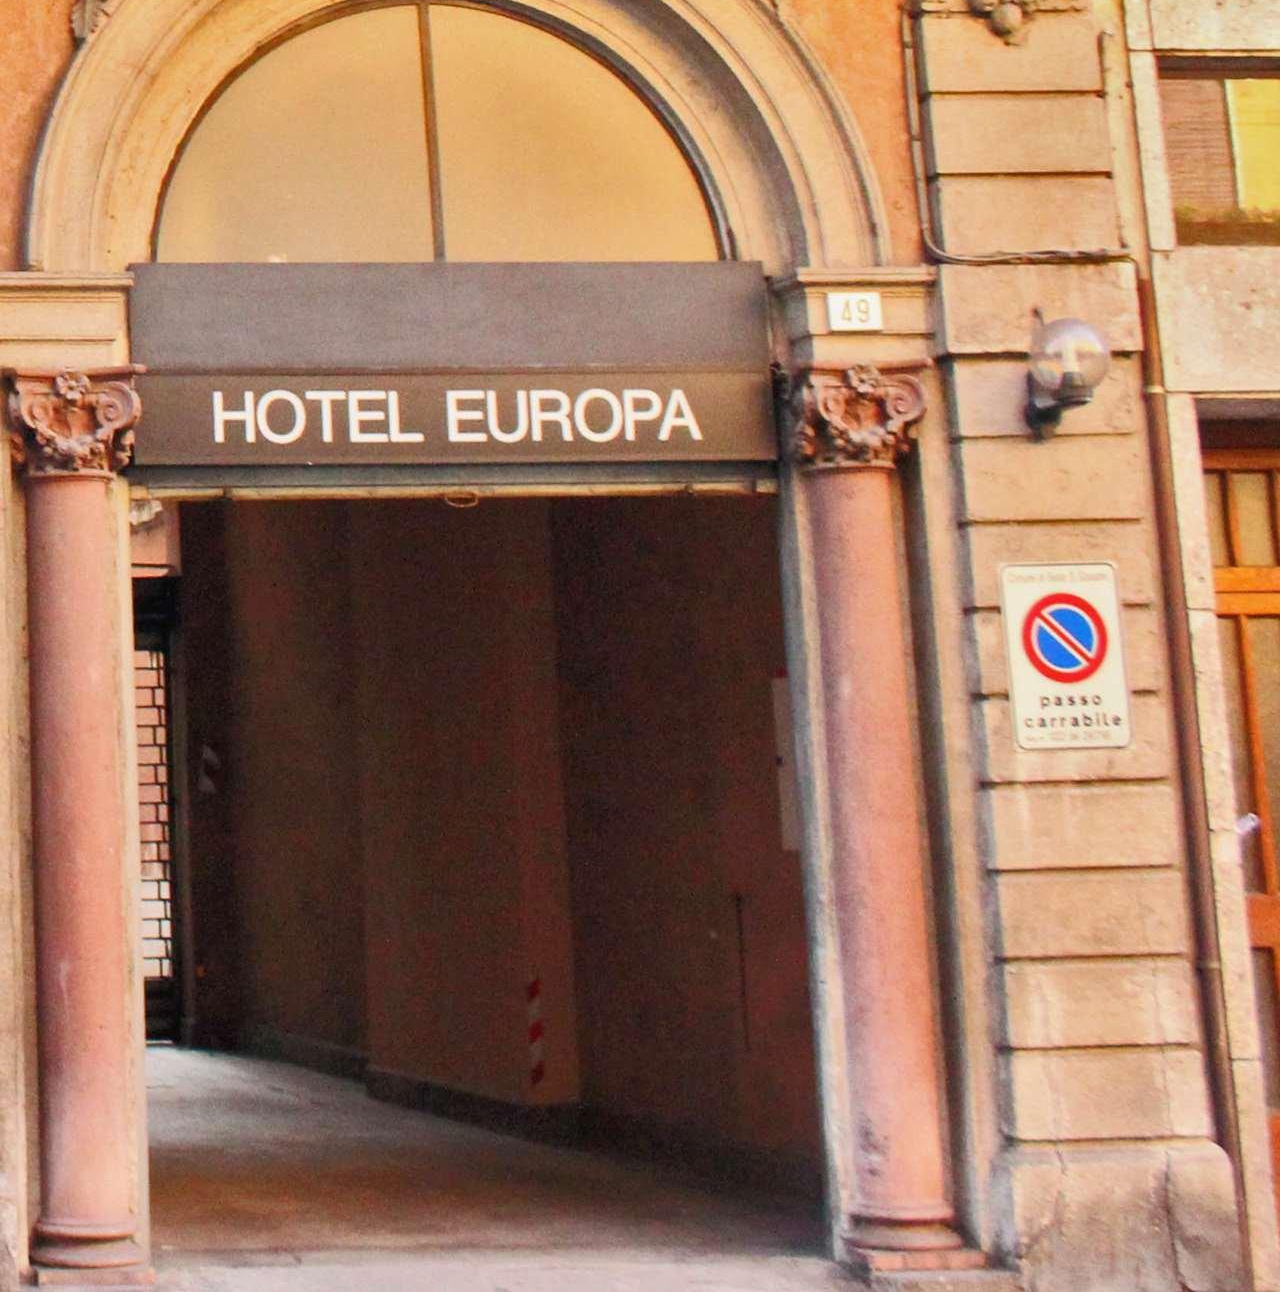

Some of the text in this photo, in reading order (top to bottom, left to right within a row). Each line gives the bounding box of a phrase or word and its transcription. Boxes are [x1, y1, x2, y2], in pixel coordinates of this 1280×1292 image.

[840, 299, 870, 324] 49
[212, 387, 703, 445] HOTEL EUROPA
[1040, 694, 1103, 709] passo
[1024, 712, 1122, 729] carrabile
